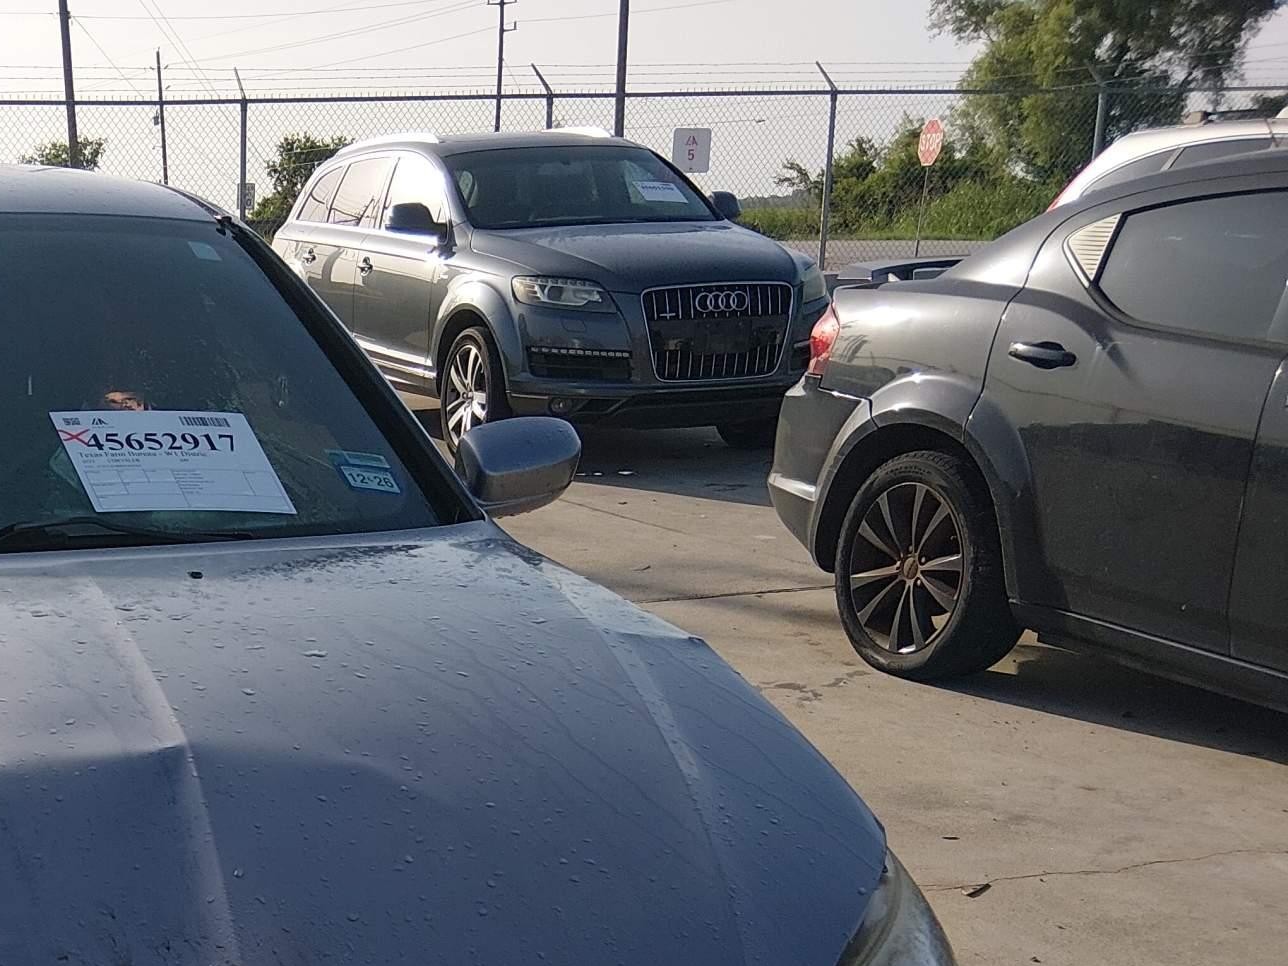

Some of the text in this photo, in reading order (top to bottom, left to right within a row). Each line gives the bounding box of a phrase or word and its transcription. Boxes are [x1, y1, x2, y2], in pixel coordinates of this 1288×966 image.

[920, 133, 942, 151] STOP
[687, 149, 695, 161] 5
[86, 432, 235, 452] 45652917
